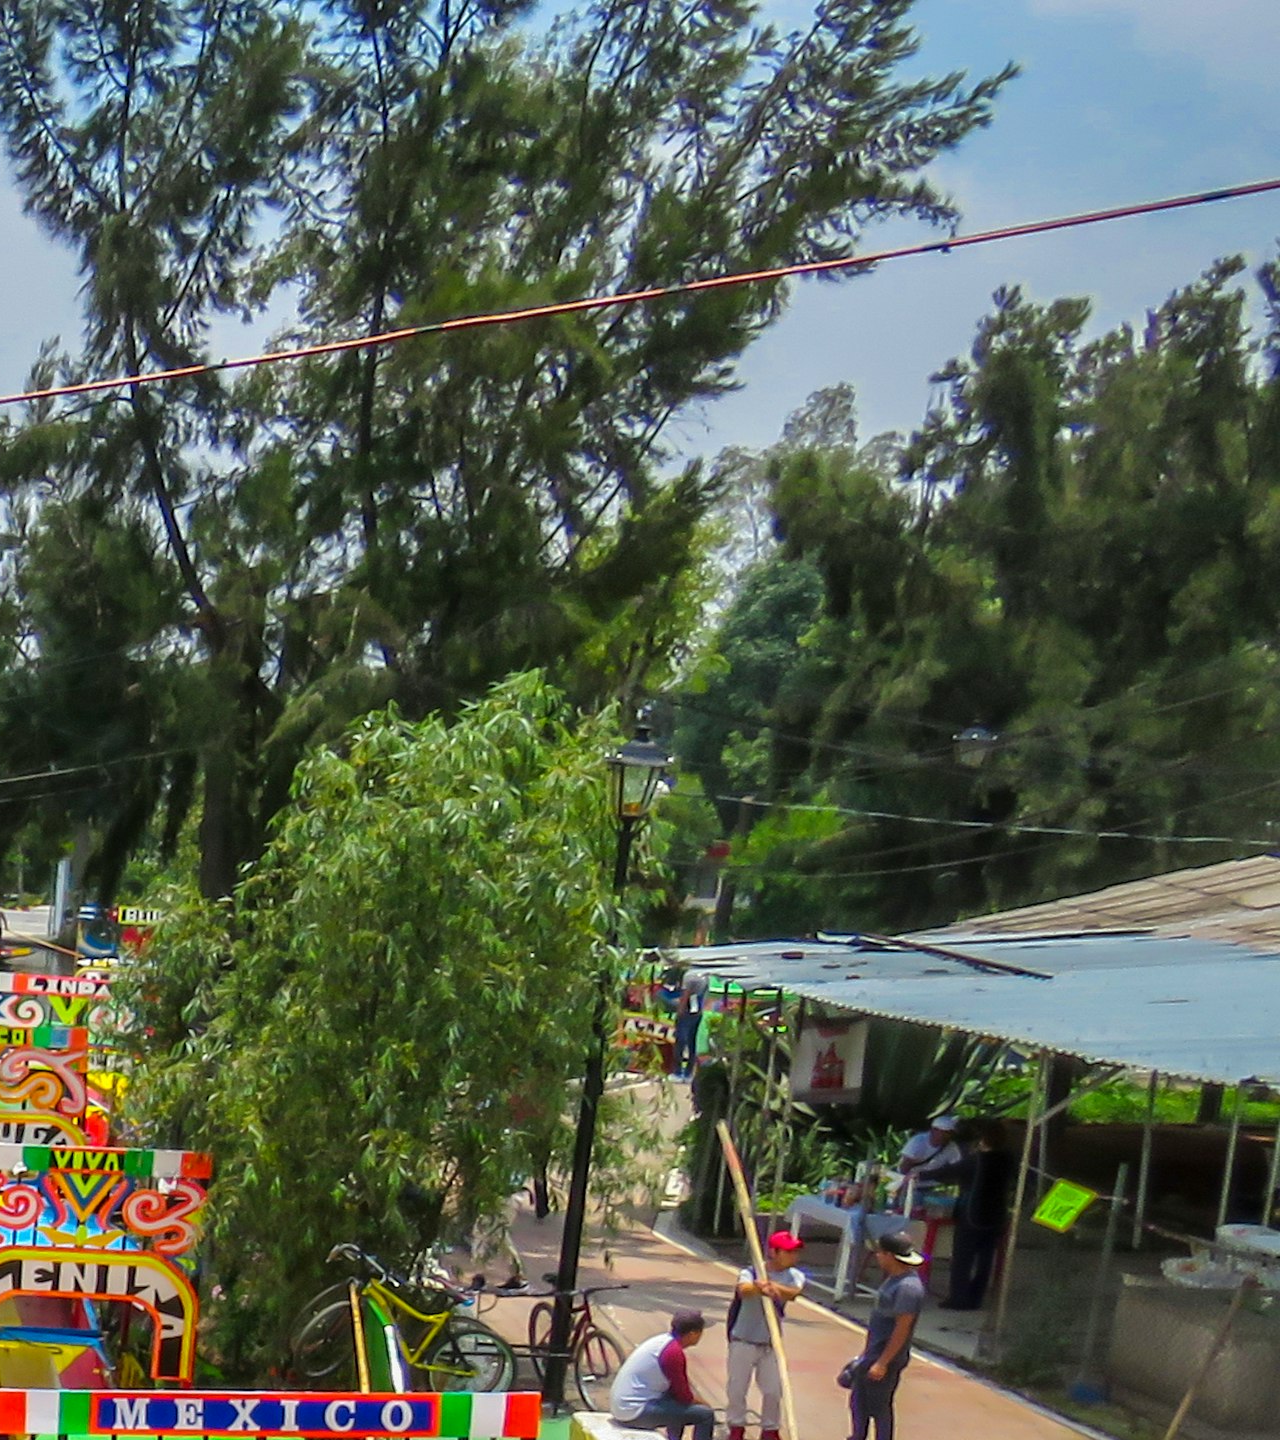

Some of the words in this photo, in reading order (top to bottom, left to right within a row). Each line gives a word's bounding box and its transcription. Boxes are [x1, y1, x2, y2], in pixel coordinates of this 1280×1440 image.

[31, 977, 112, 997] LINDA
[54, 1150, 121, 1171] VIVA
[112, 1398, 414, 1433] MEXICO
